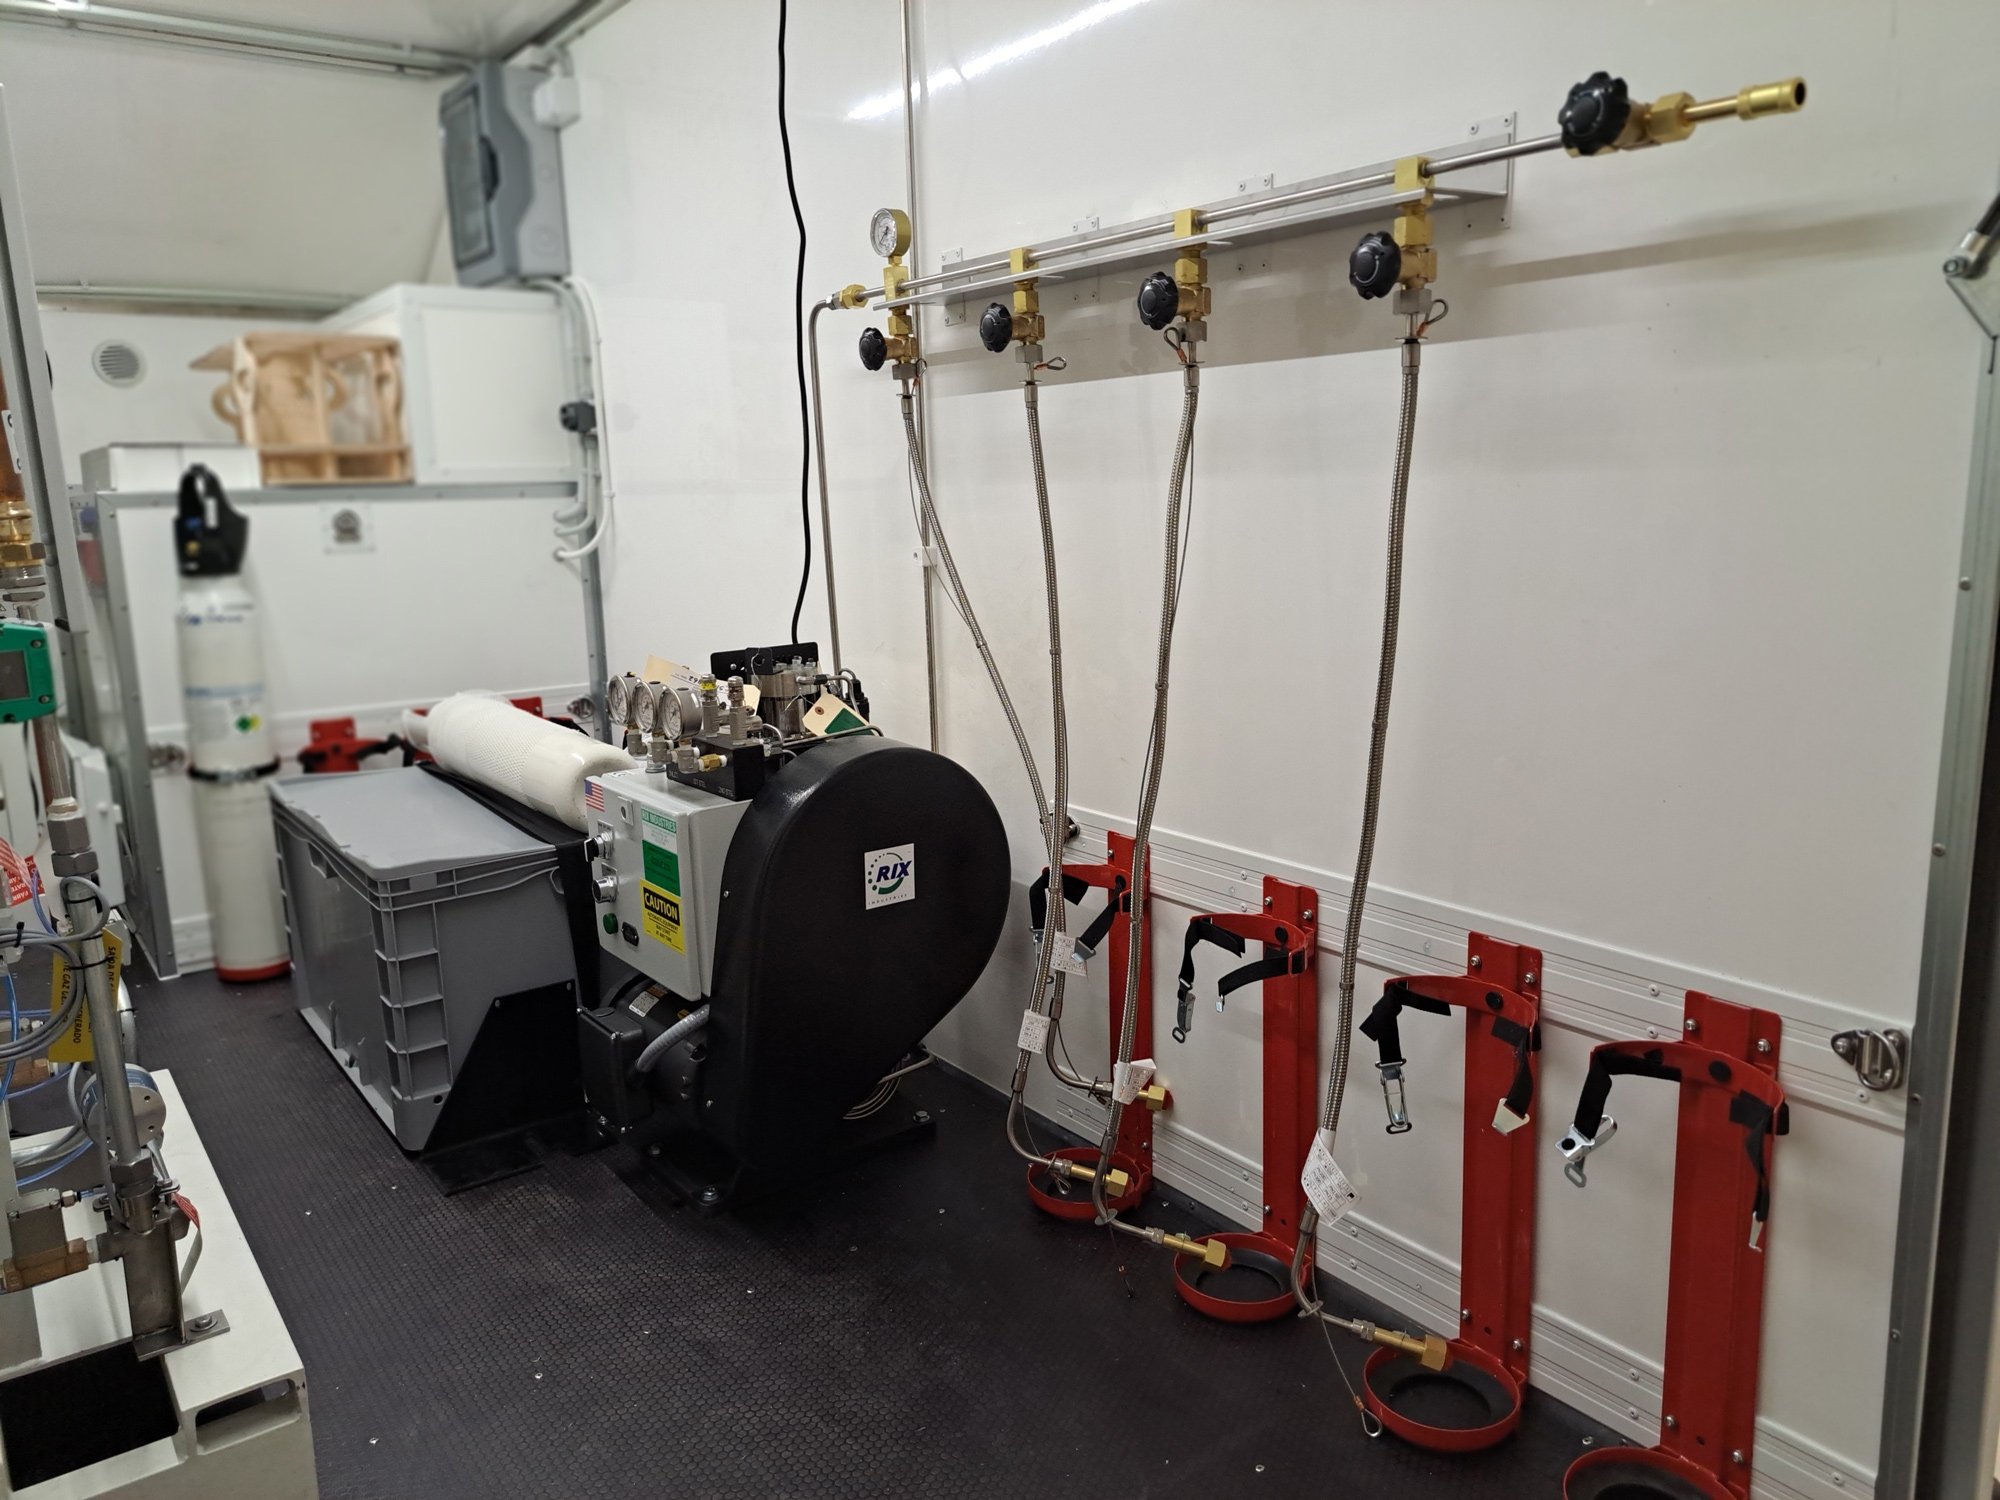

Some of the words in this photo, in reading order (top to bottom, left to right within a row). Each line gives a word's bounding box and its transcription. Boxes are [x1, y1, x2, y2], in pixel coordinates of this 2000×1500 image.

[650, 812, 676, 834] INDUSTRIES
[876, 860, 912, 883] RIX
[644, 892, 678, 921] CAUTION
[868, 893, 907, 905] INDUSTRIES
